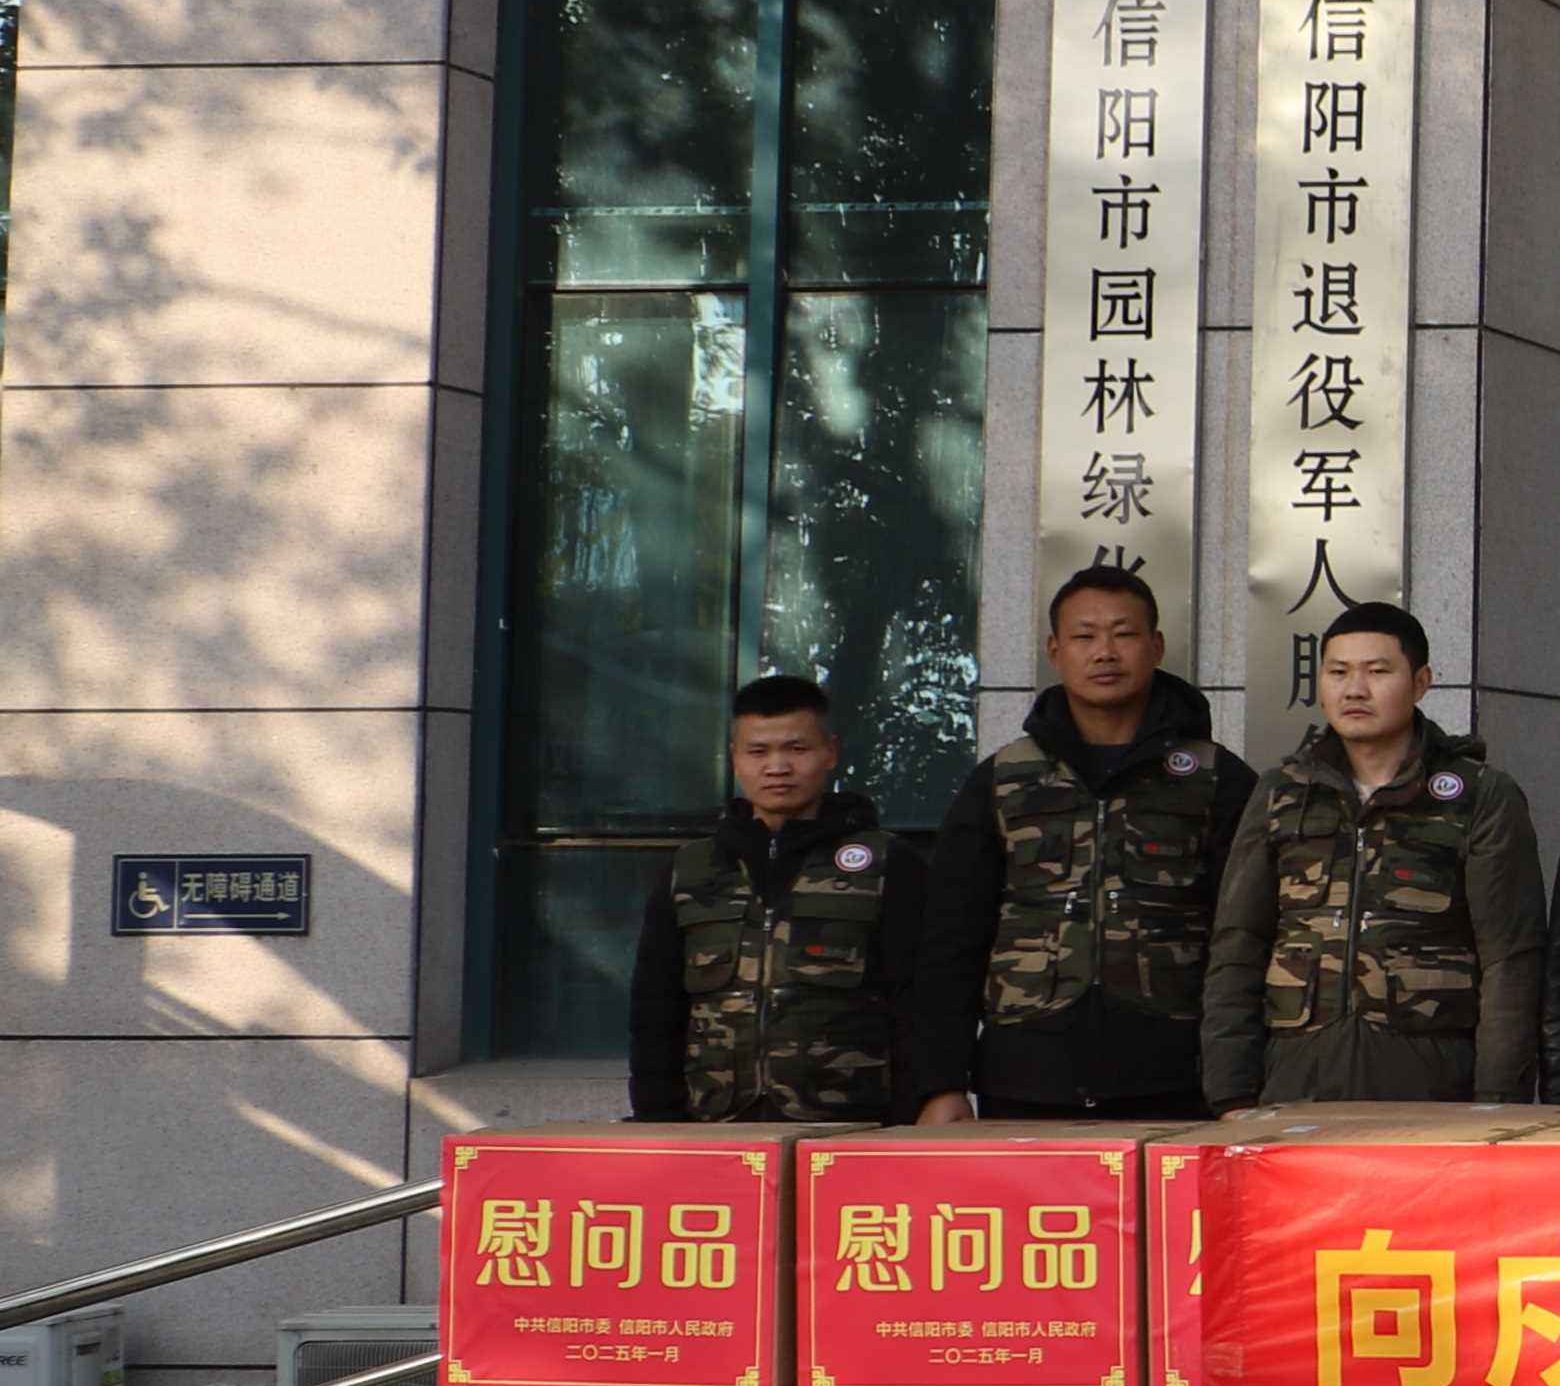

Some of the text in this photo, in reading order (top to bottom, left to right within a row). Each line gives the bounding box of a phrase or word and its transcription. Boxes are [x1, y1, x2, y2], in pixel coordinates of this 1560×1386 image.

[180, 870, 301, 903] 无障碍通道
[476, 1198, 737, 1289] 慰问品
[836, 1203, 1098, 1292] 慰问品
[513, 1316, 734, 1337] 中共信阳市委 信阳市人民政府
[875, 1320, 1097, 1338] 中共信阳市委 信阳市人民政府
